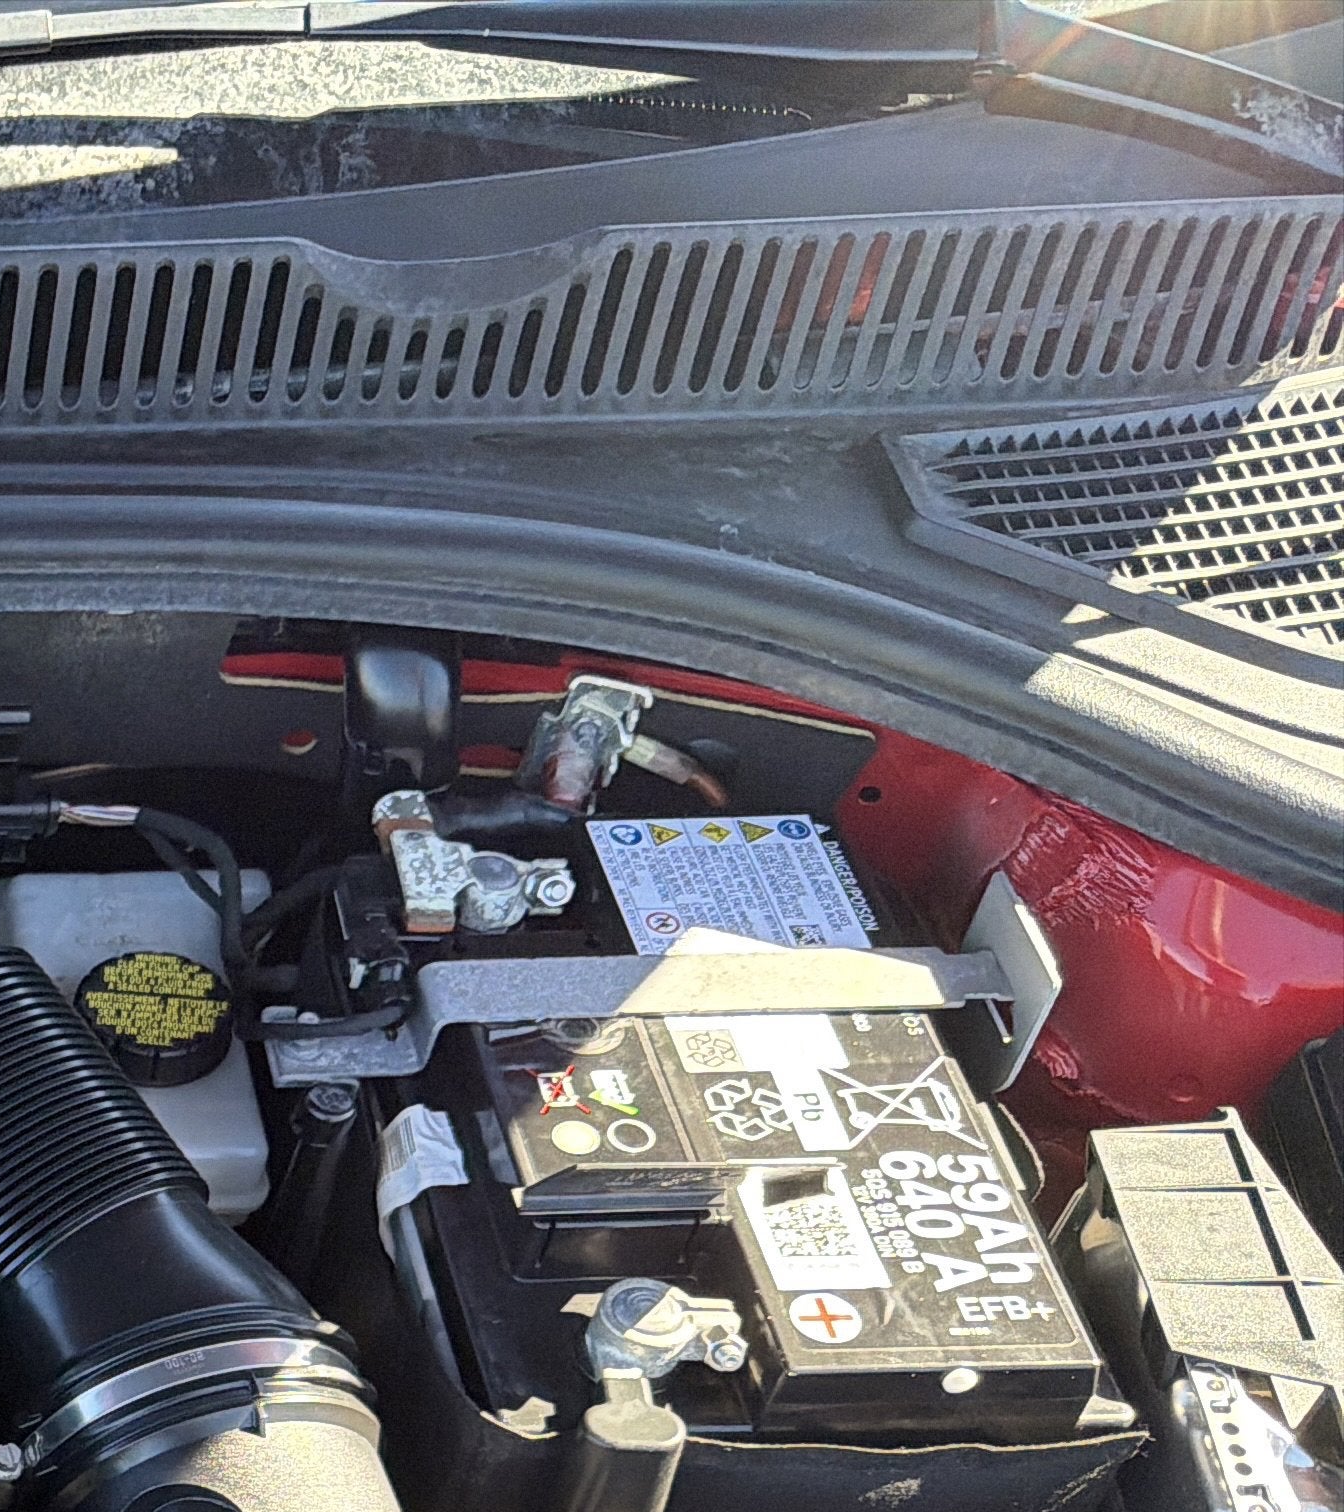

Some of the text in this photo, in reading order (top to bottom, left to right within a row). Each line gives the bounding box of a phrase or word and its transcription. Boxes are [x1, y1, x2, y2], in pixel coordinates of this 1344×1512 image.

[823, 841, 880, 931] DANGER/POISON
[104, 966, 140, 977] BEFORE
[194, 973, 213, 982] USE
[117, 958, 200, 973] CLEAN FILLER CAP
[103, 975, 127, 985] ONLY
[157, 978, 183, 988] FLUID
[186, 981, 213, 990] FROM
[116, 983, 151, 992] SEALED
[152, 986, 205, 997] CONTAINER
[88, 1000, 131, 1010] BOUCHON
[96, 1016, 132, 1027] LIQUIDE
[161, 1022, 215, 1033] PROVENANT
[140, 1028, 195, 1040] CONTENANT
[793, 1092, 825, 1122] Pb
[879, 1150, 965, 1240] 640
[875, 1202, 904, 1228] 915
[938, 1153, 1043, 1285] 59Ah
[873, 1235, 898, 1259] DIN
[889, 1229, 919, 1259] 089
[902, 1260, 925, 1274] B
[920, 1251, 988, 1293] A
[956, 1295, 1057, 1322] EFB+
